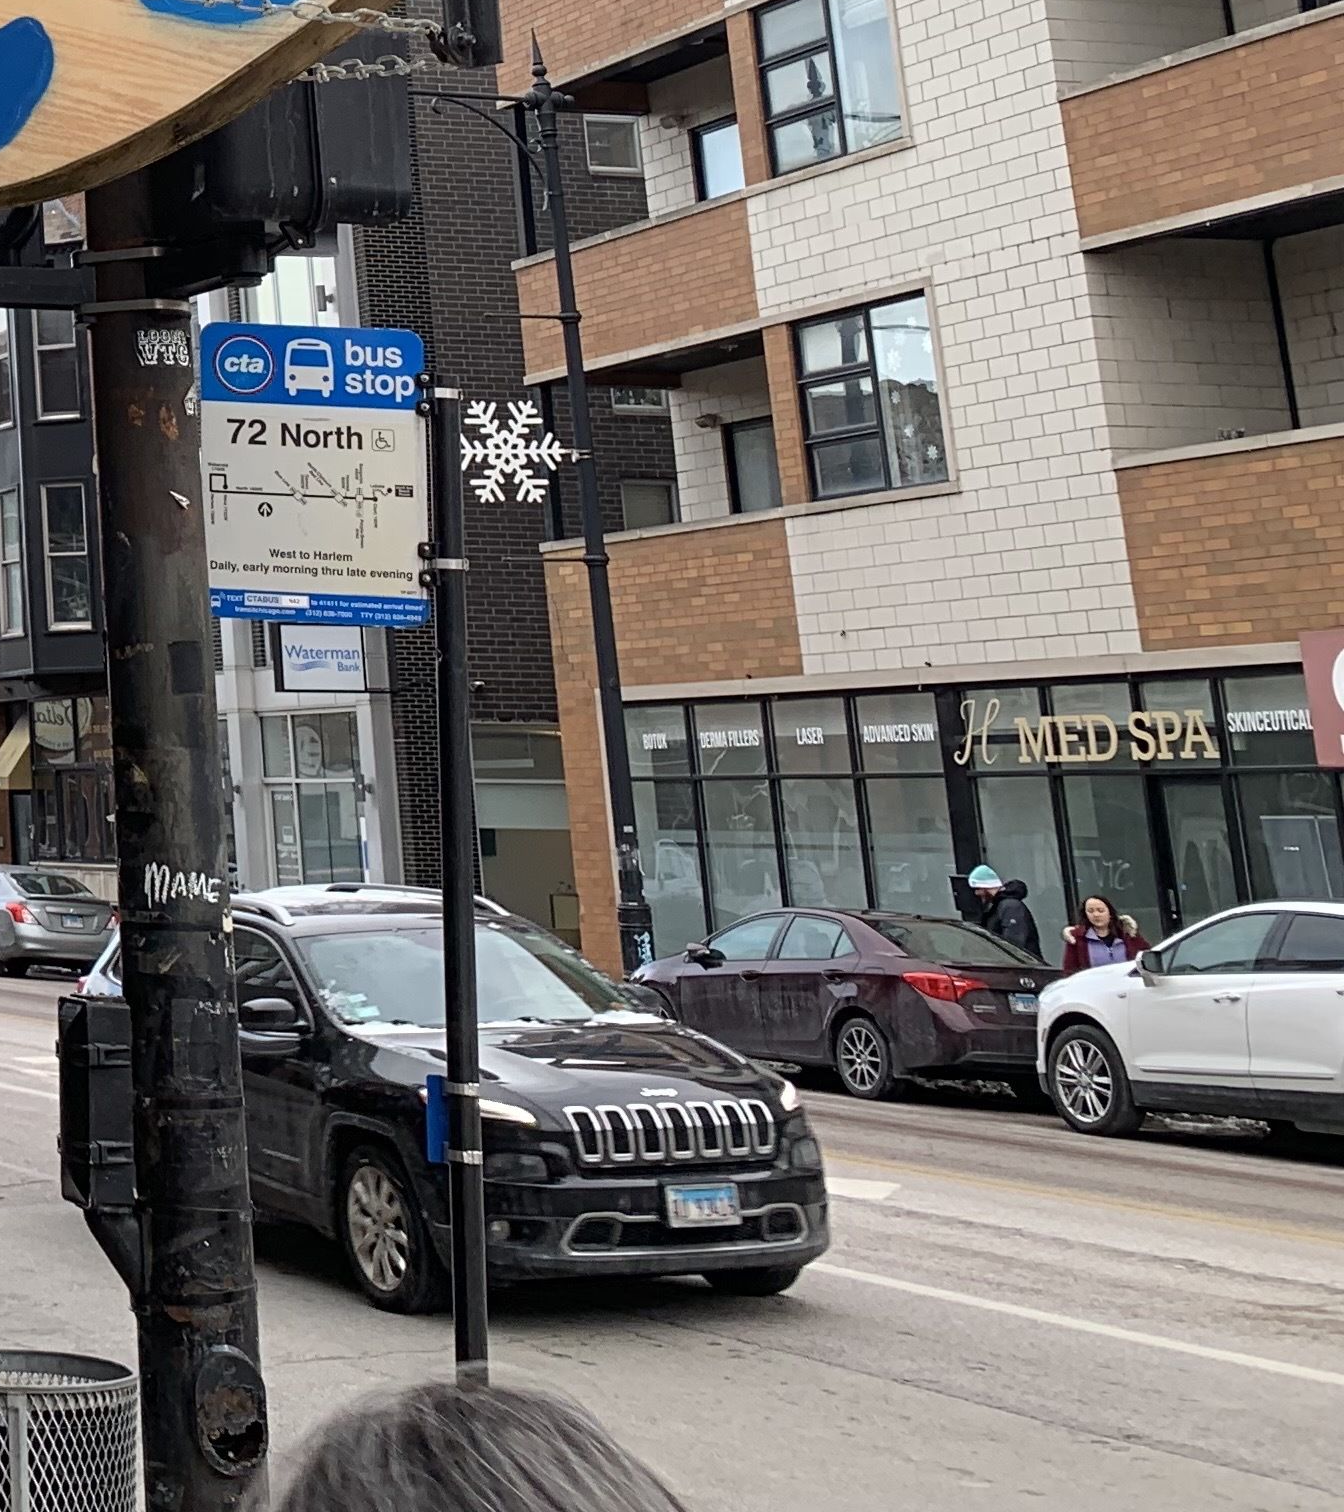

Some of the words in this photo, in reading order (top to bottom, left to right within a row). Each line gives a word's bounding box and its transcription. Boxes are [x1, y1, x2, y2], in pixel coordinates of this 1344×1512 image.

[345, 339, 403, 368] bus
[224, 354, 265, 374] cta
[344, 370, 415, 403] stop
[226, 418, 267, 445] 72
[280, 422, 363, 450] North
[269, 548, 297, 559] West
[299, 551, 310, 560] to
[313, 551, 353, 562] Harlem
[210, 560, 240, 573] Daily,
[243, 563, 269, 575] early
[272, 565, 318, 577] morning
[321, 566, 344, 577] thru
[347, 567, 367, 578] late
[370, 570, 413, 582] evening
[246, 595, 280, 604] CTABUS
[284, 645, 360, 660] Waterman
[337, 662, 361, 672] Bank
[642, 733, 668, 749] BOTOX
[700, 731, 728, 749] DERMA
[728, 729, 760, 747] FILLERS
[796, 727, 824, 745] LASER
[863, 724, 911, 743] ADVANCED
[912, 723, 935, 742] SKIN
[1014, 714, 1119, 764] MED
[1128, 709, 1221, 762] SPA
